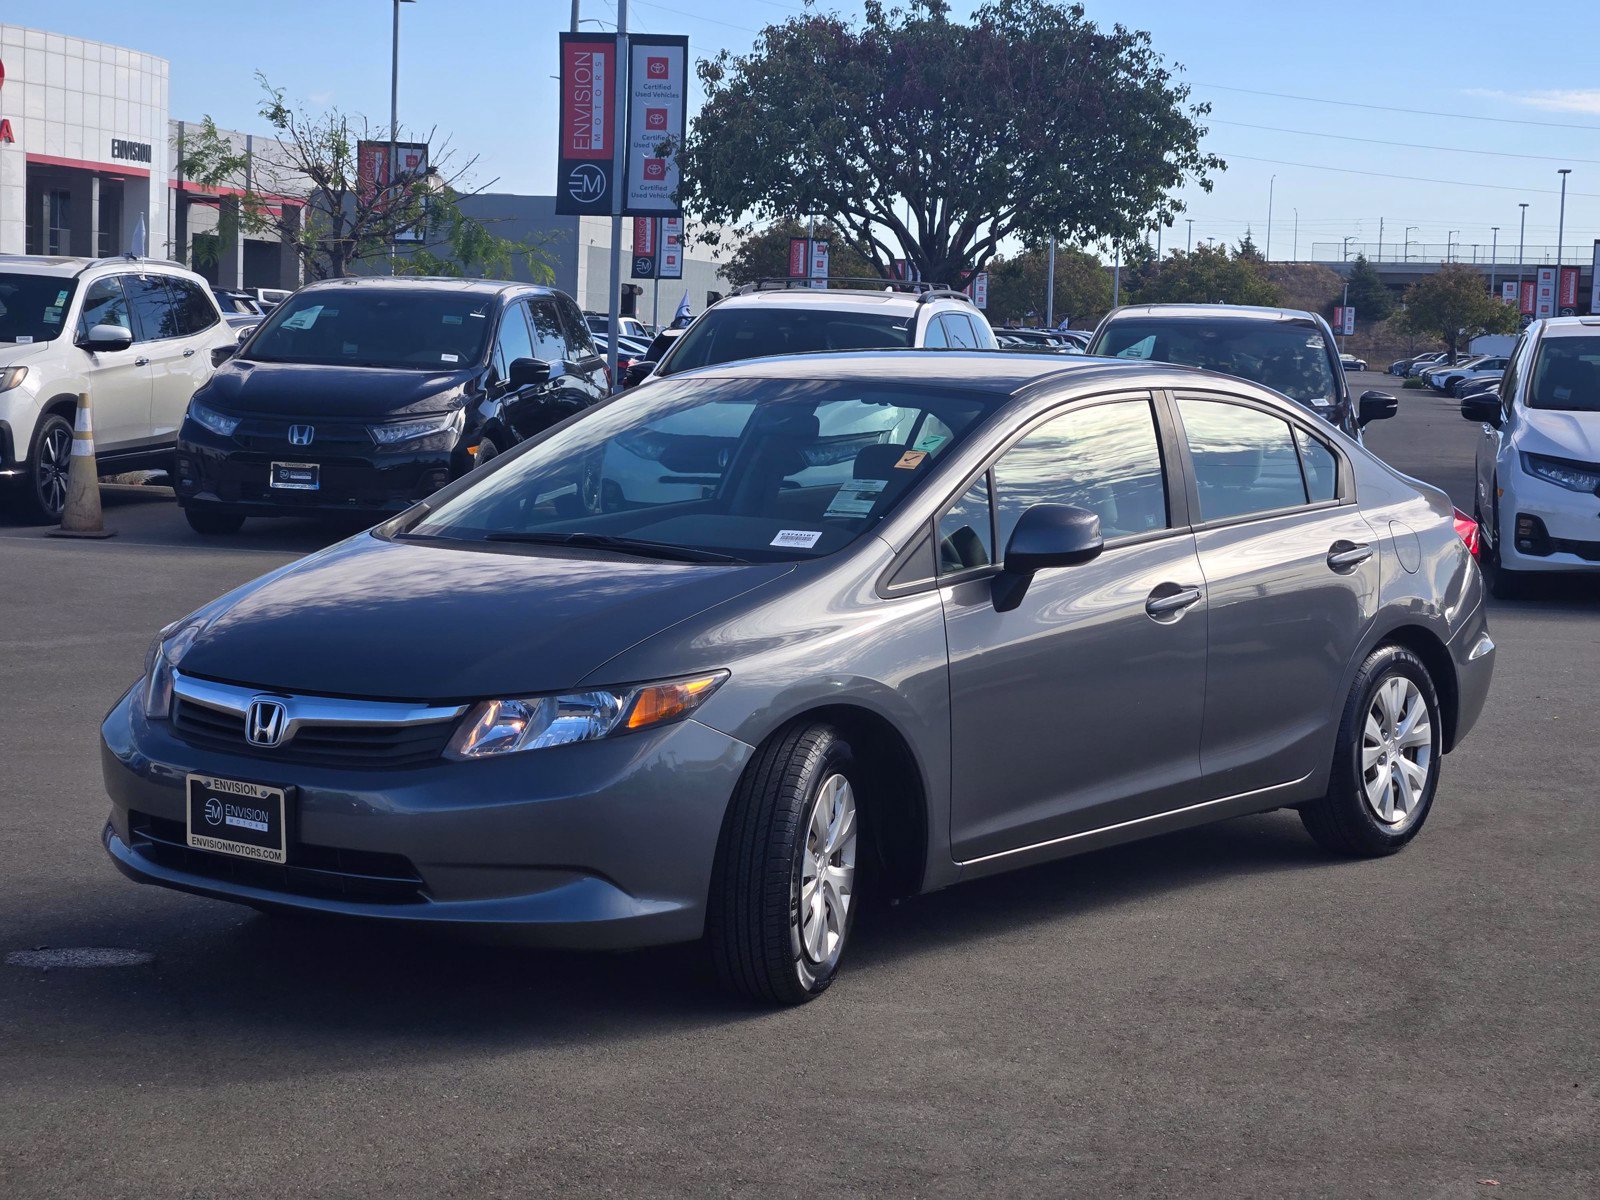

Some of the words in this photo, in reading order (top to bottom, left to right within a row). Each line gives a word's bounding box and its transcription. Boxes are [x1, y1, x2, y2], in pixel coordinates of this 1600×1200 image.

[574, 52, 591, 150] ENVISION
[594, 61, 602, 142] MOTORS
[111, 138, 152, 163] ENVISION
[638, 217, 647, 253] ENVISIO
[214, 780, 258, 796] ENVISION
[225, 804, 269, 822] ENVISION
[229, 818, 266, 830] MOTORS
[191, 837, 282, 860] ENVISIONMOTORS.COM
